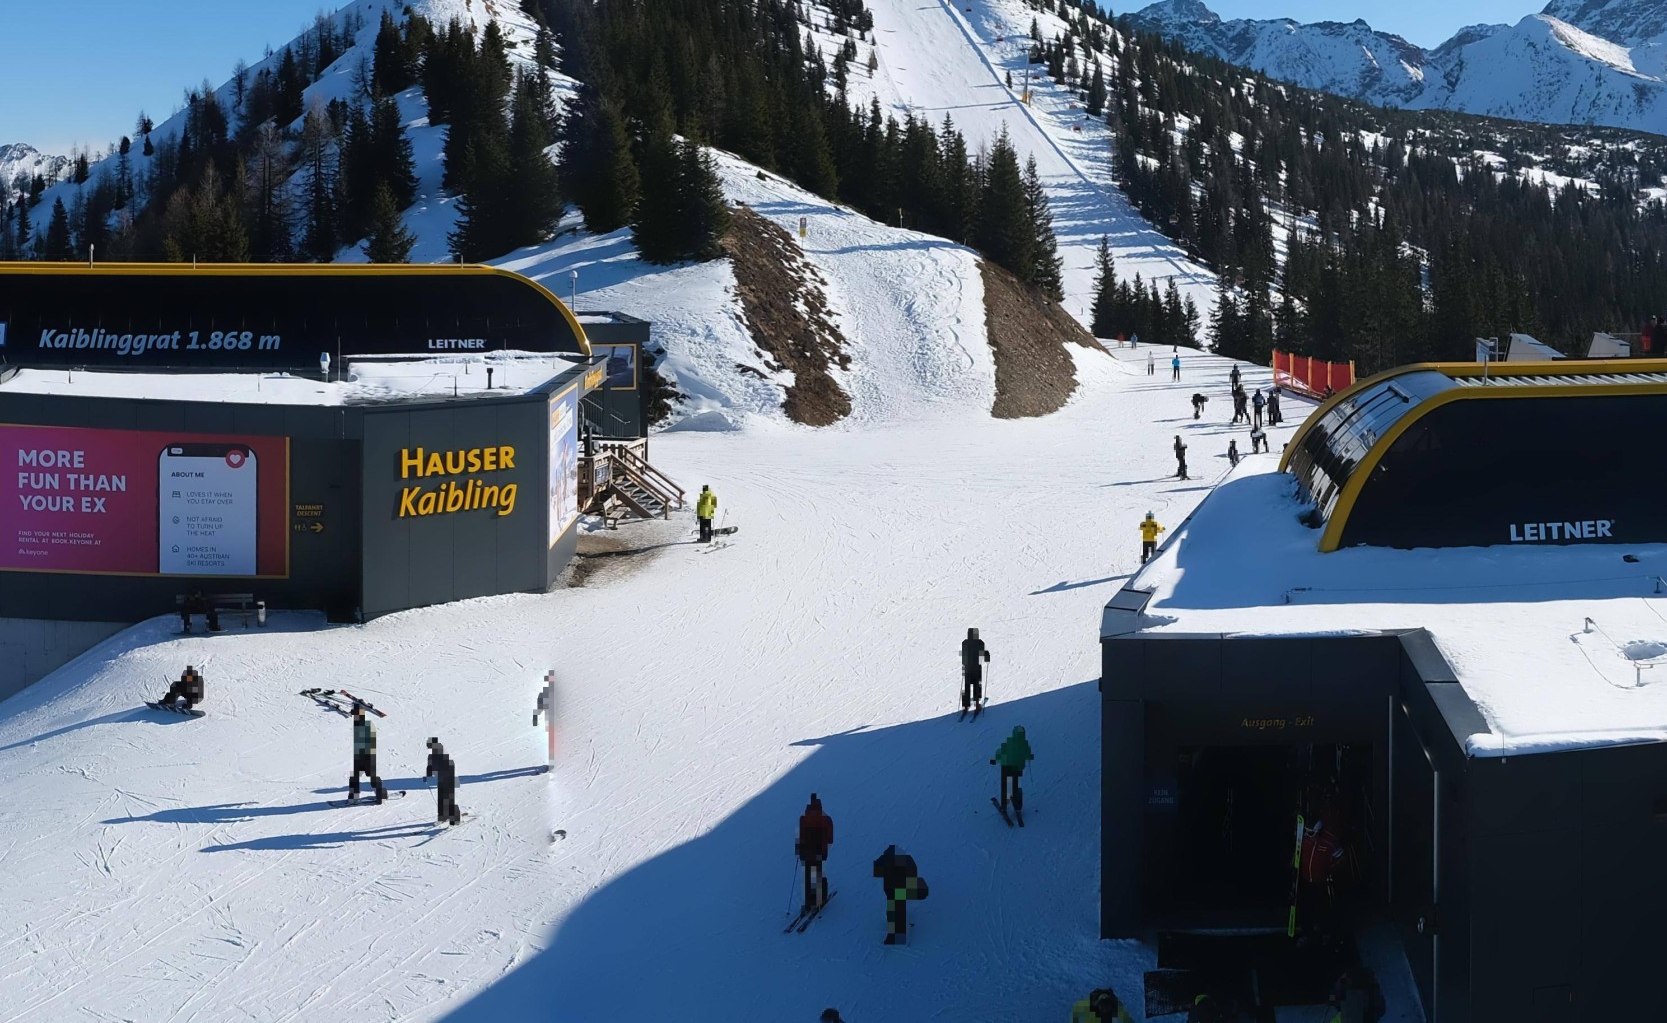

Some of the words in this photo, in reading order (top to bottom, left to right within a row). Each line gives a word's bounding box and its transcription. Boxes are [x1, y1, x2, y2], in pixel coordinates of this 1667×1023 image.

[39, 328, 181, 356] Kaiblinggrat
[185, 330, 252, 350] 1.868
[258, 335, 281, 350] m
[18, 449, 85, 468] MORE
[401, 446, 515, 479] HAUSER
[18, 472, 60, 490] FUN
[66, 473, 127, 492] THAN
[18, 494, 75, 512] YOUR
[81, 497, 107, 513] EX
[399, 479, 518, 517] Kaibling
[1241, 718, 1286, 729] Ausgang
[1295, 715, 1315, 726] Exit
